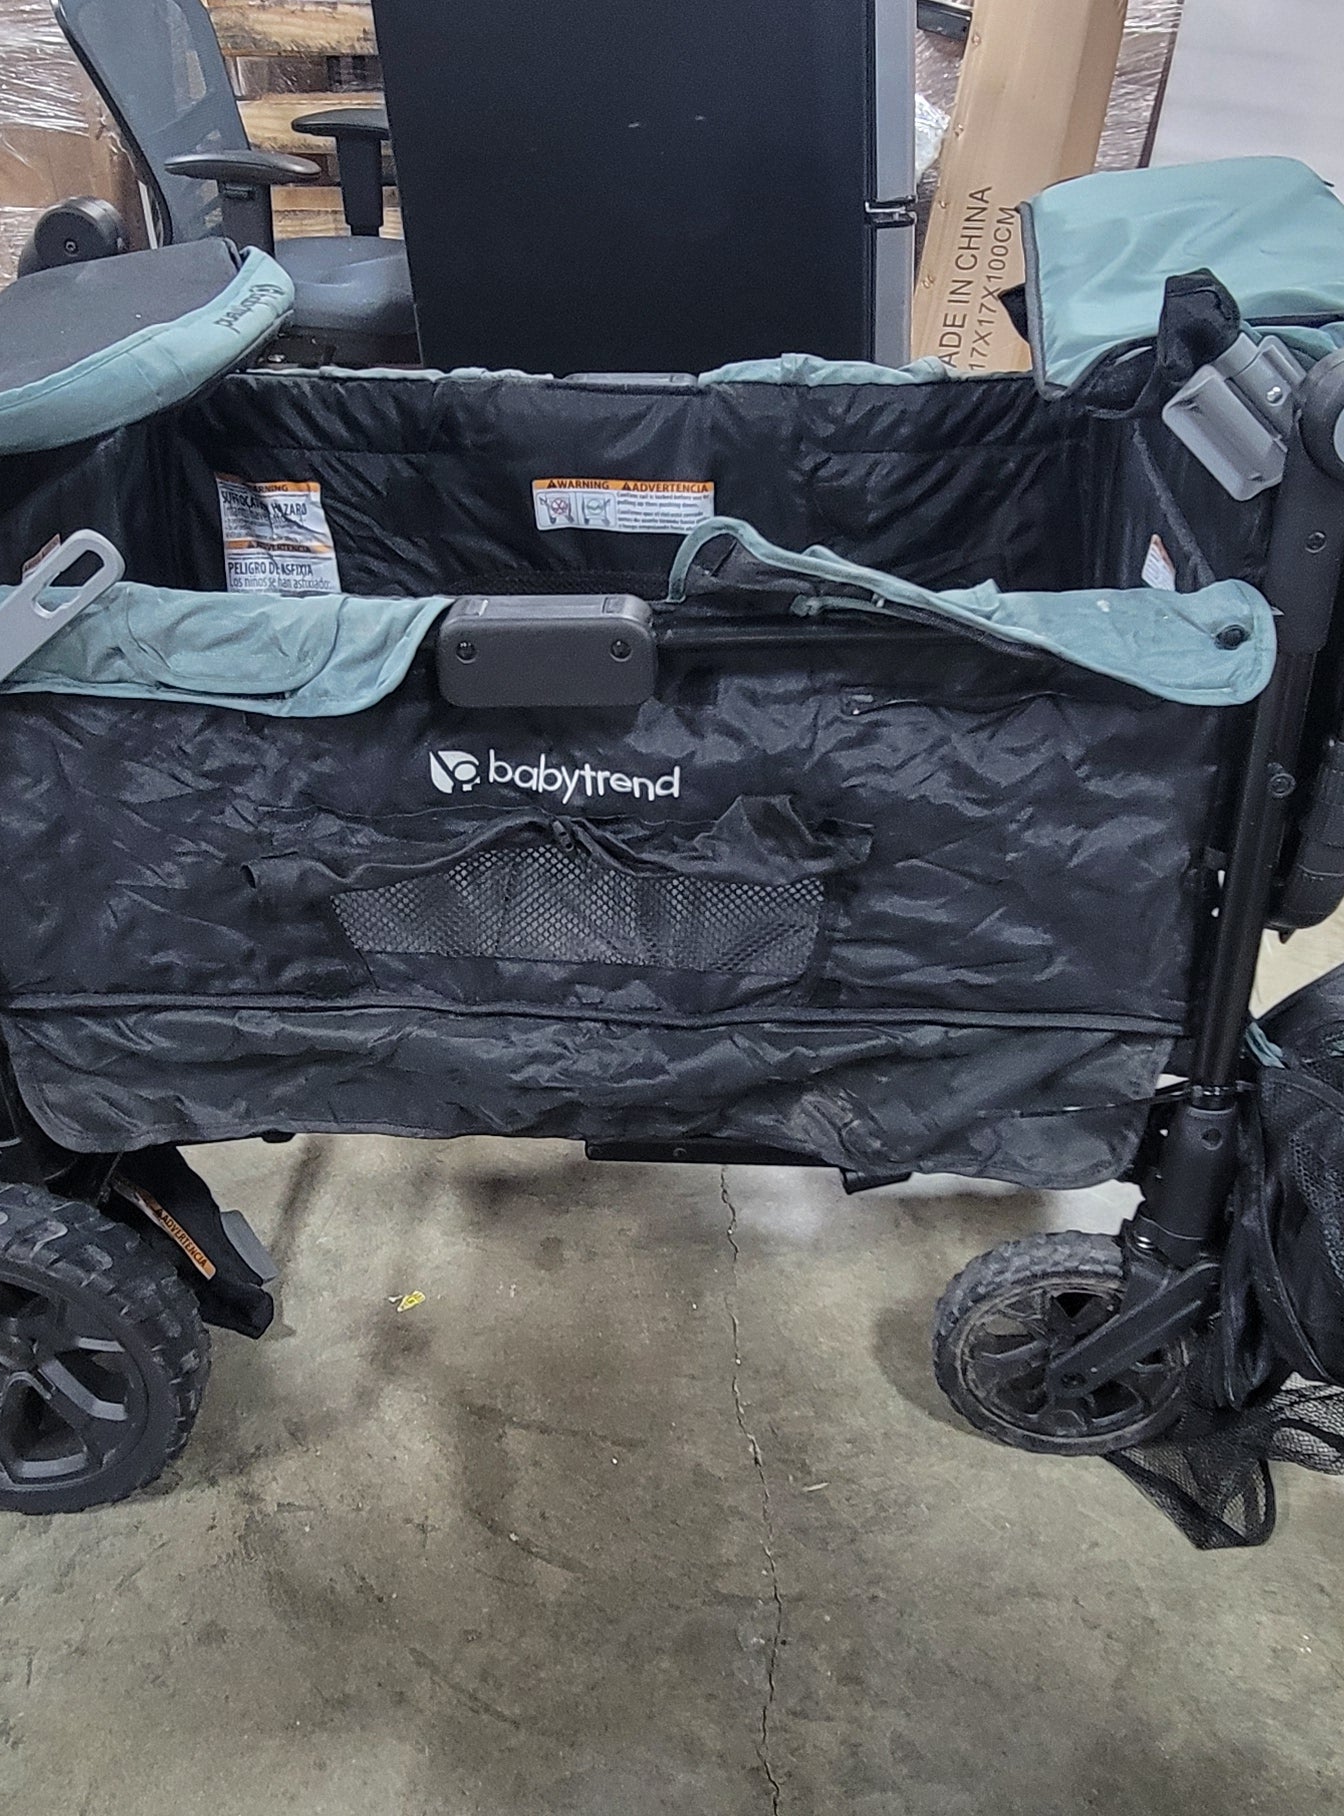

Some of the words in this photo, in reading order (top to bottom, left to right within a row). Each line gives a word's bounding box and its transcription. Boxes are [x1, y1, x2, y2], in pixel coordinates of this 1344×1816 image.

[955, 186, 992, 271] CHINA
[947, 280, 974, 304] IN
[968, 206, 1016, 371] 17X17X100CM
[939, 313, 967, 368] ADE
[556, 480, 609, 490] WARNING
[632, 482, 708, 493] ADVERTENCIA
[228, 562, 267, 576] PELIGRO
[489, 750, 681, 804] babytrend
[162, 1214, 207, 1268] ADVERTENCIA
